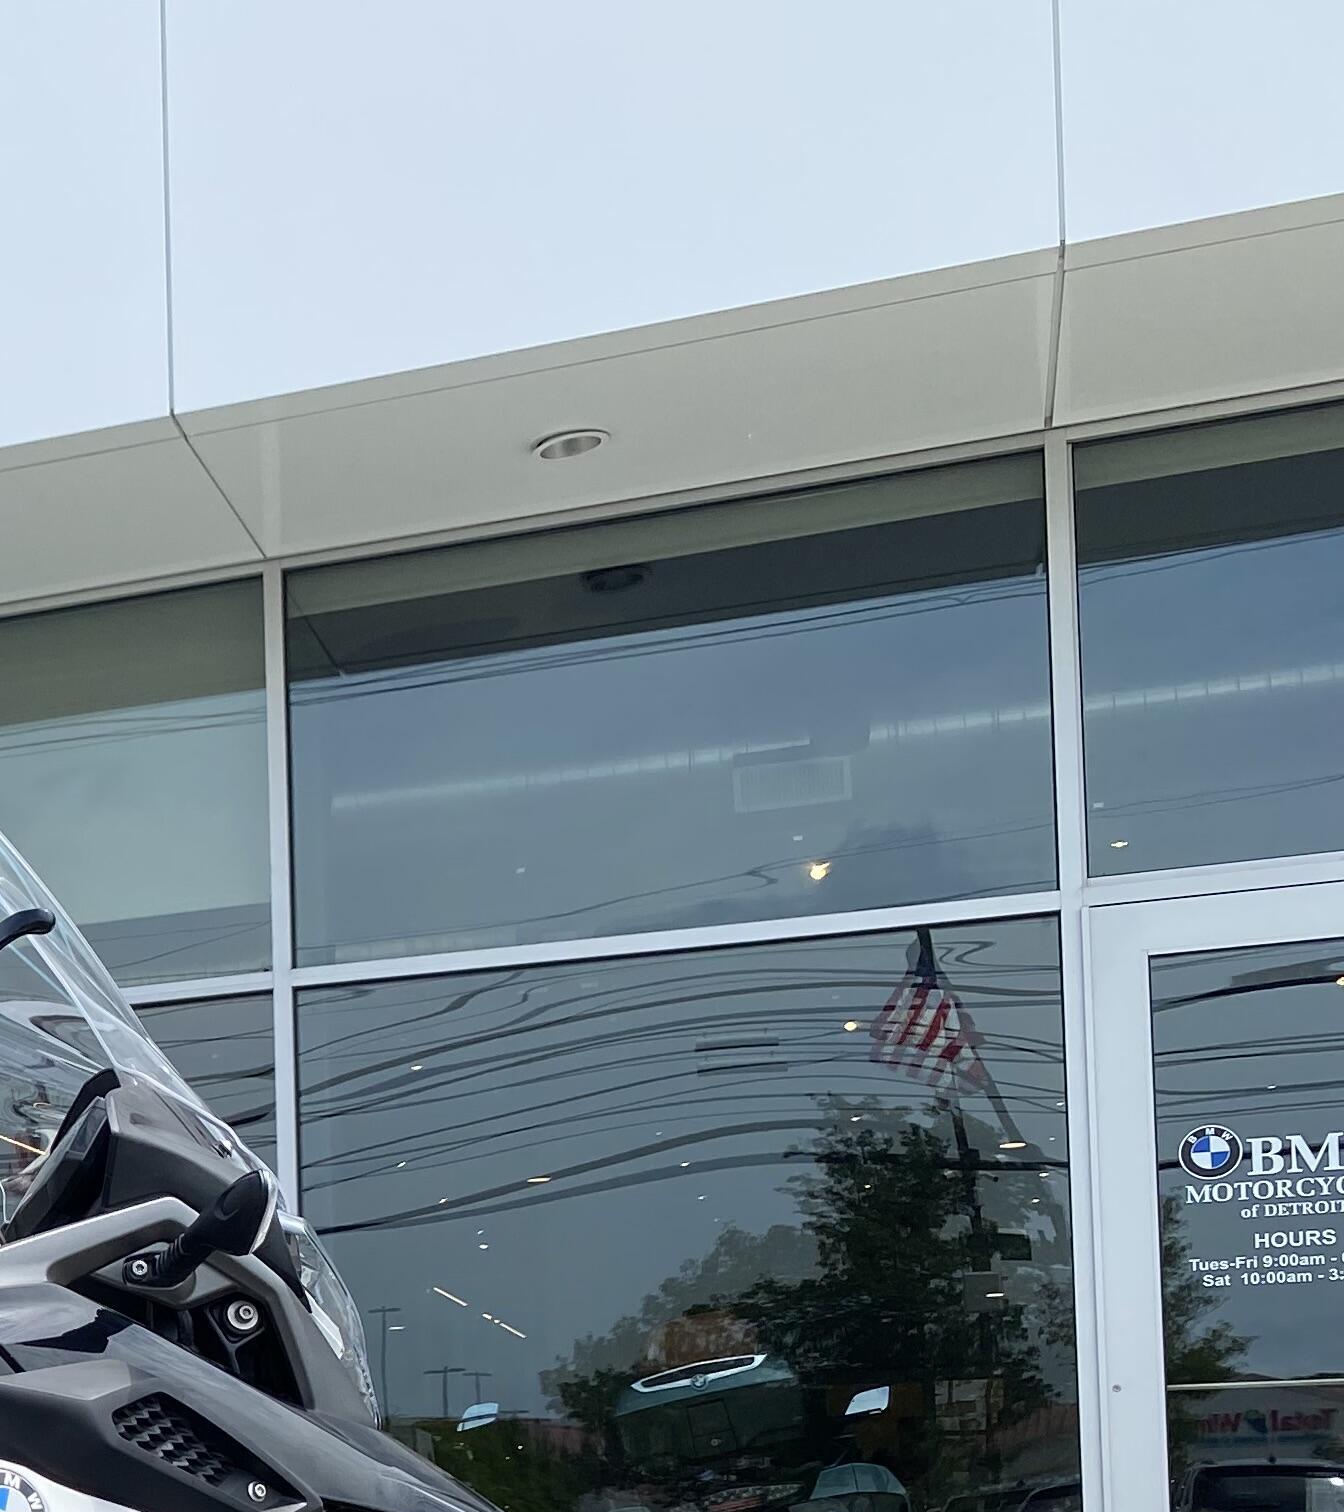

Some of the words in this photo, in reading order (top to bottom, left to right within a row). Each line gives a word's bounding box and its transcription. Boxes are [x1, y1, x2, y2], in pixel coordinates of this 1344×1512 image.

[1246, 1132, 1344, 1176] BM
[1241, 1204, 1260, 1218] of
[1254, 1229, 1337, 1249] HOURS
[1189, 1255, 1258, 1272] Tues-Fri
[1262, 1252, 1325, 1268] 9:00am
[1202, 1274, 1231, 1287] Sat
[1241, 1271, 1313, 1285] 10:00am
